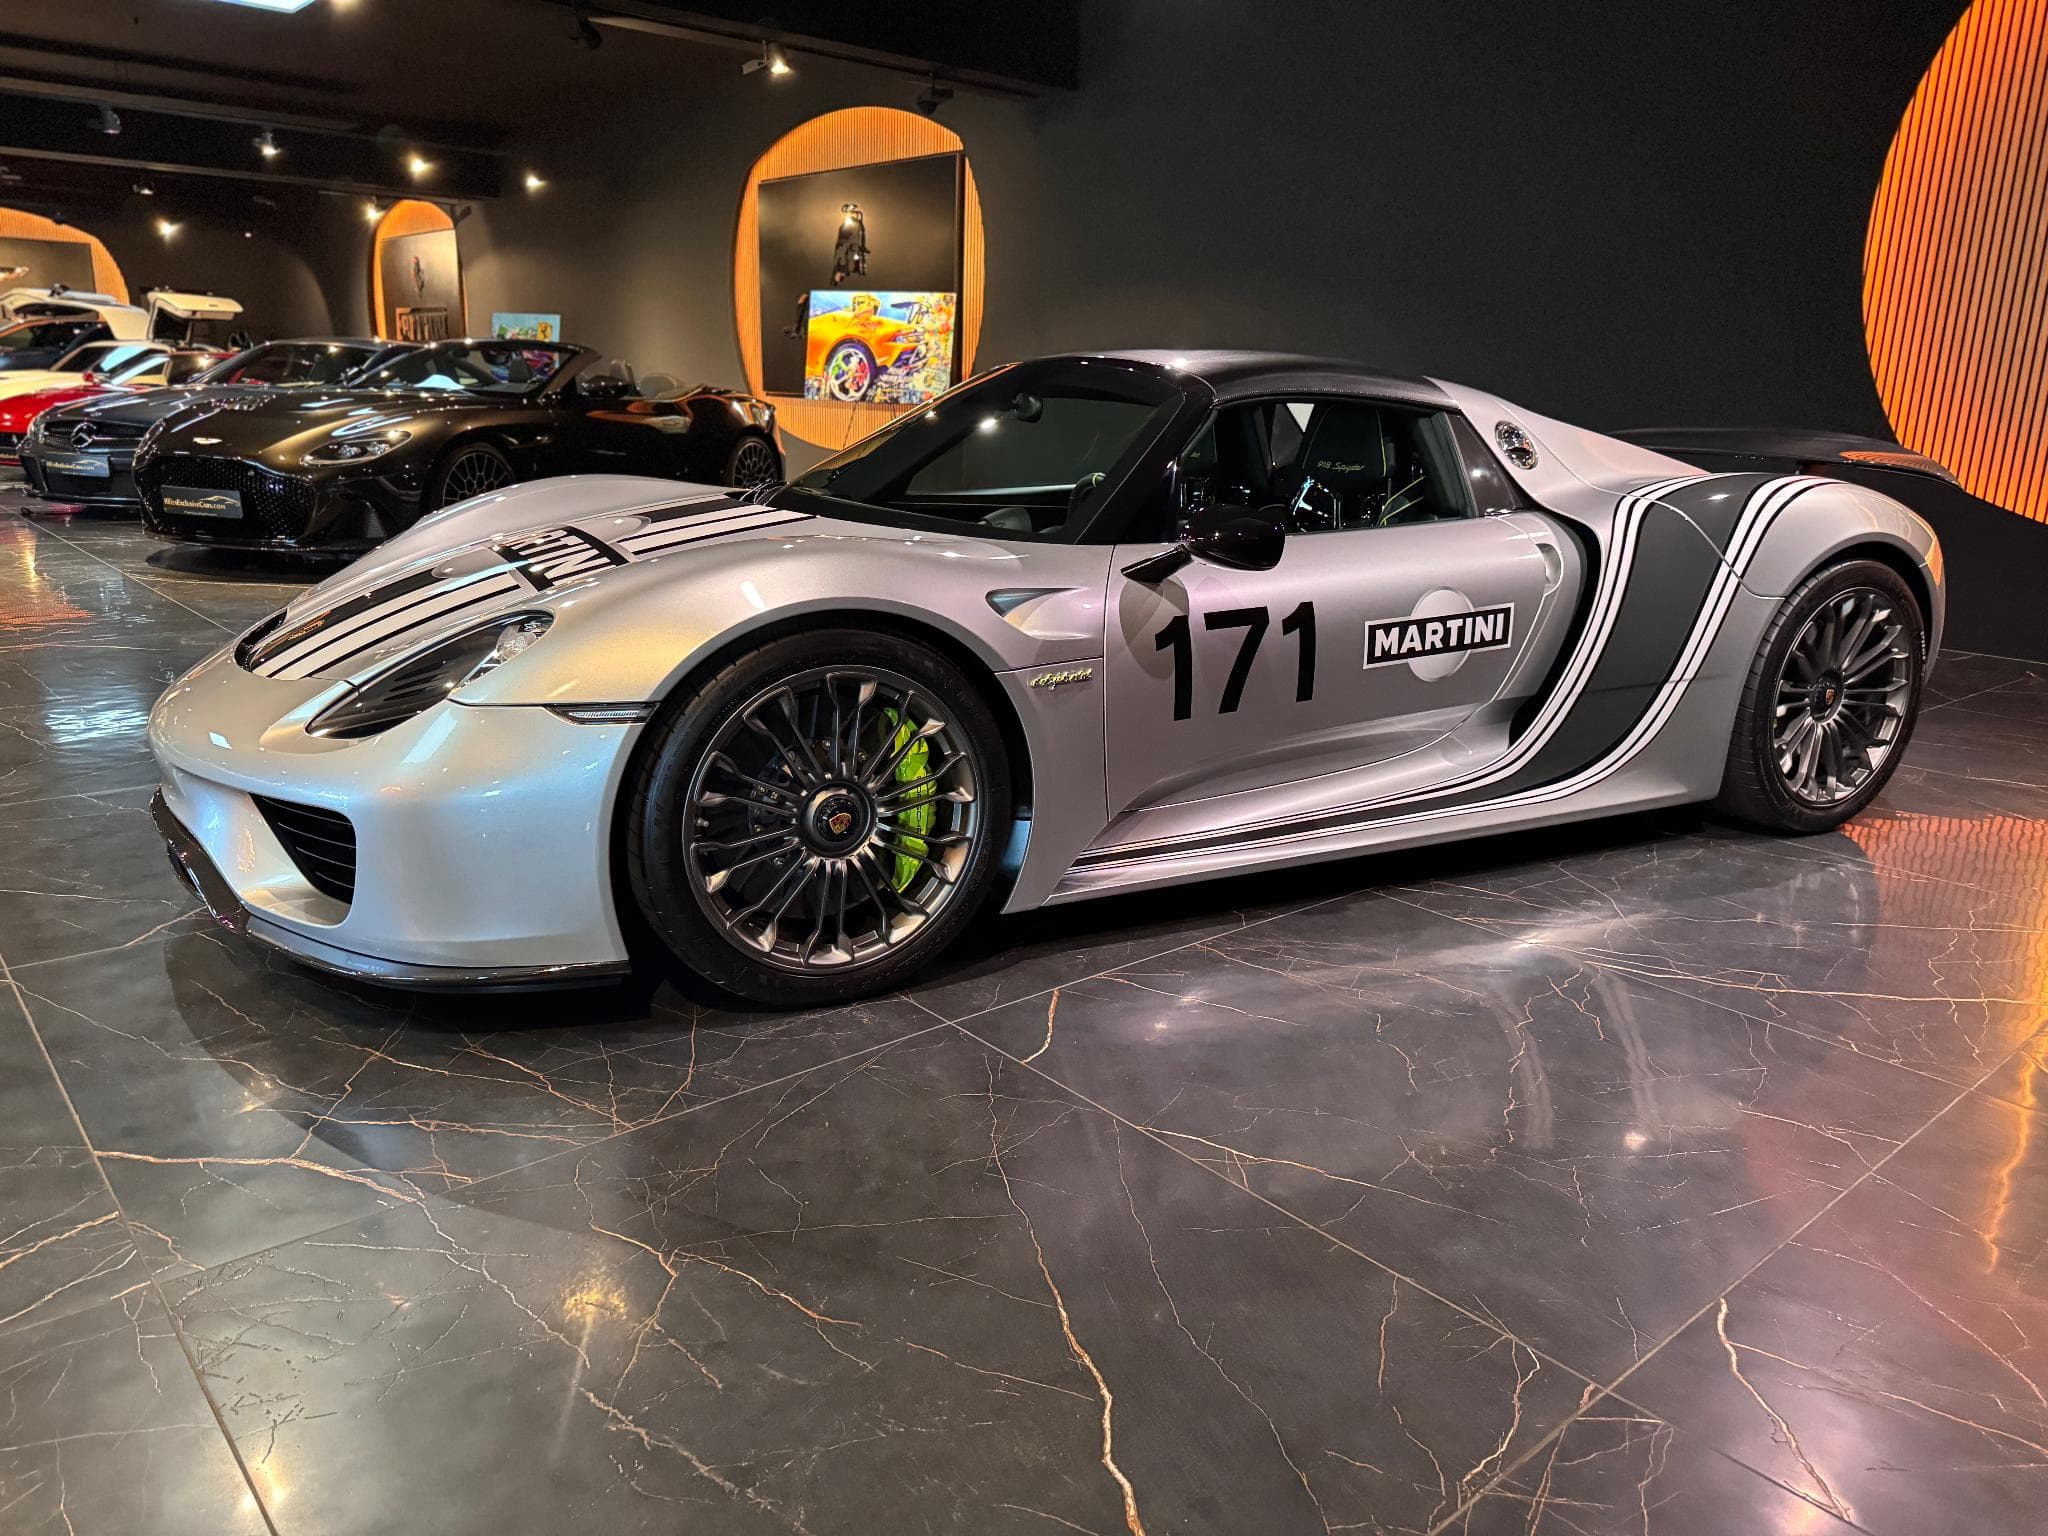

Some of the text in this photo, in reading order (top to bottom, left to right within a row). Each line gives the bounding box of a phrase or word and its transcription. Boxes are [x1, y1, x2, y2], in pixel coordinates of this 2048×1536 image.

[1331, 461, 1366, 474] Spyder
[1374, 613, 1505, 657] MARTINI
[1154, 601, 1316, 721] 171
